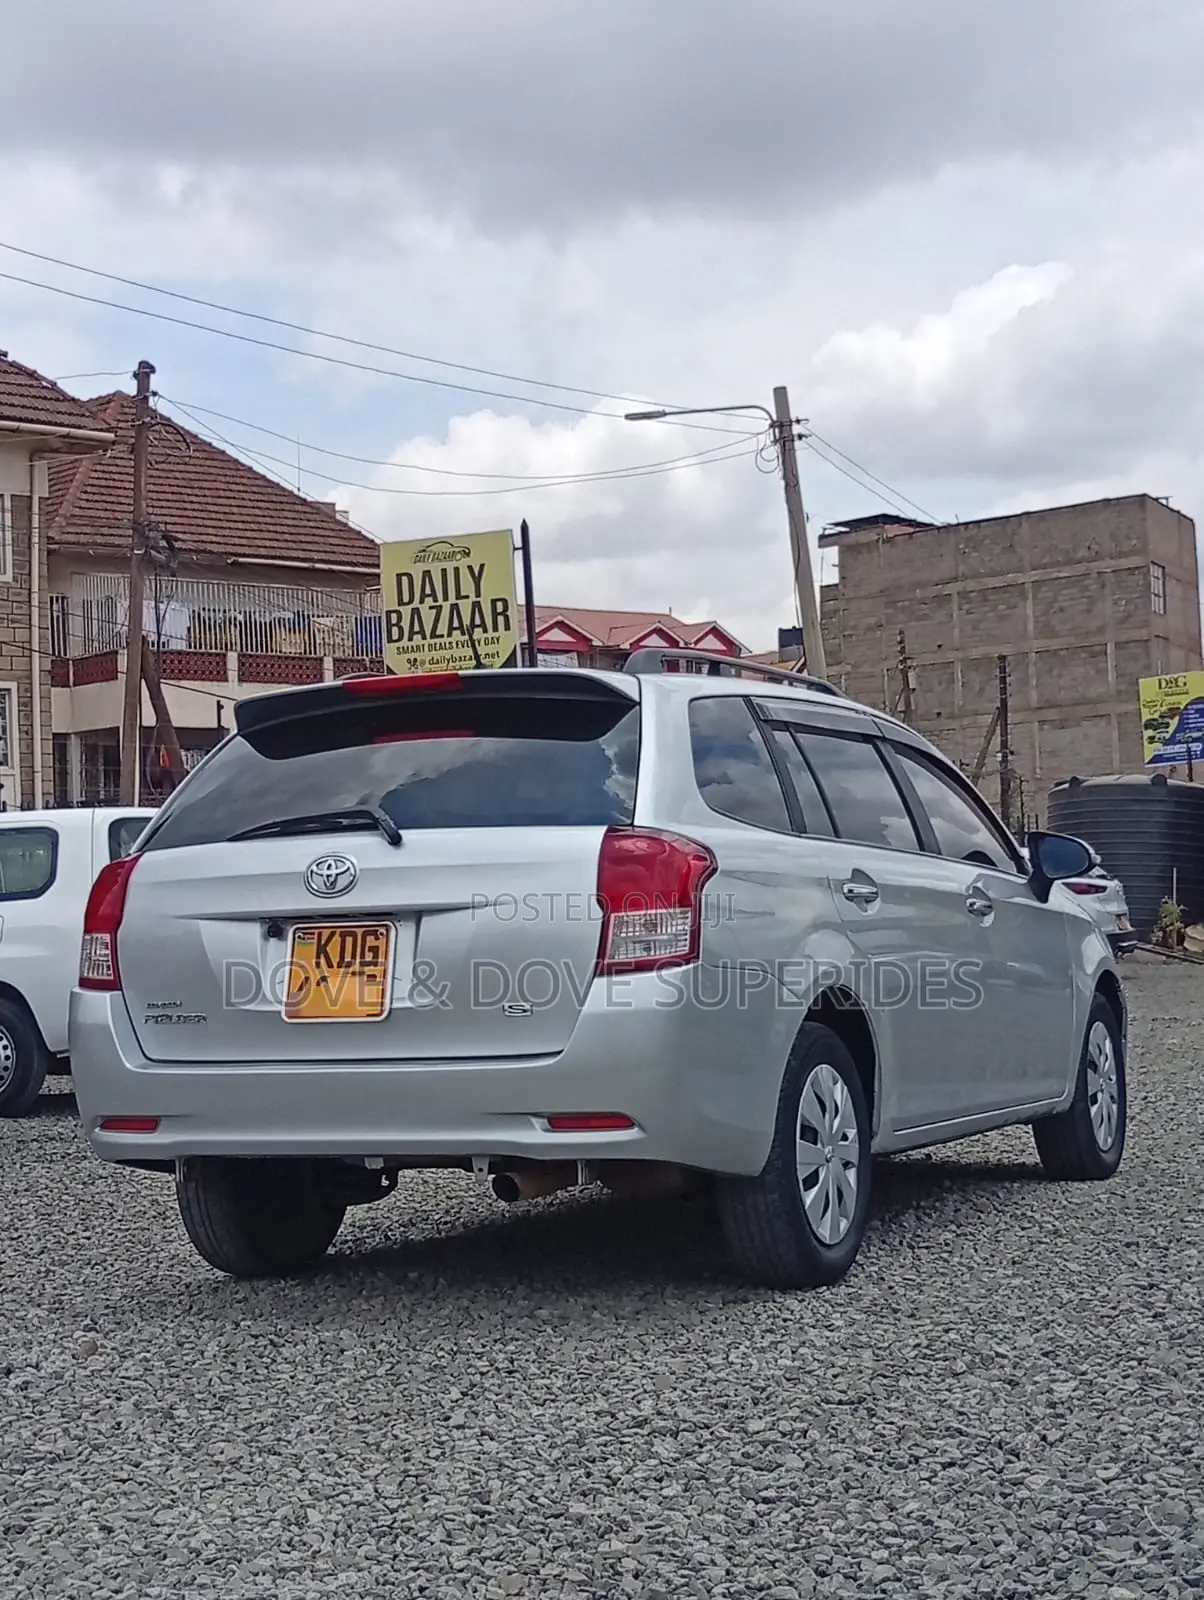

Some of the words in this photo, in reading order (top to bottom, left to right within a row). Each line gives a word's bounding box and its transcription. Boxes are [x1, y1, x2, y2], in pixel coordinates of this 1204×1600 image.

[395, 563, 486, 607] DAILY
[385, 597, 511, 644] BAZAAR
[396, 643, 425, 655] SMART
[428, 641, 455, 652] DEALS
[456, 638, 482, 650] EVEY
[484, 636, 501, 647] DAY
[428, 650, 501, 668] dailybaza.net
[1157, 675, 1187, 690] D&G
[314, 930, 381, 969] KDG
